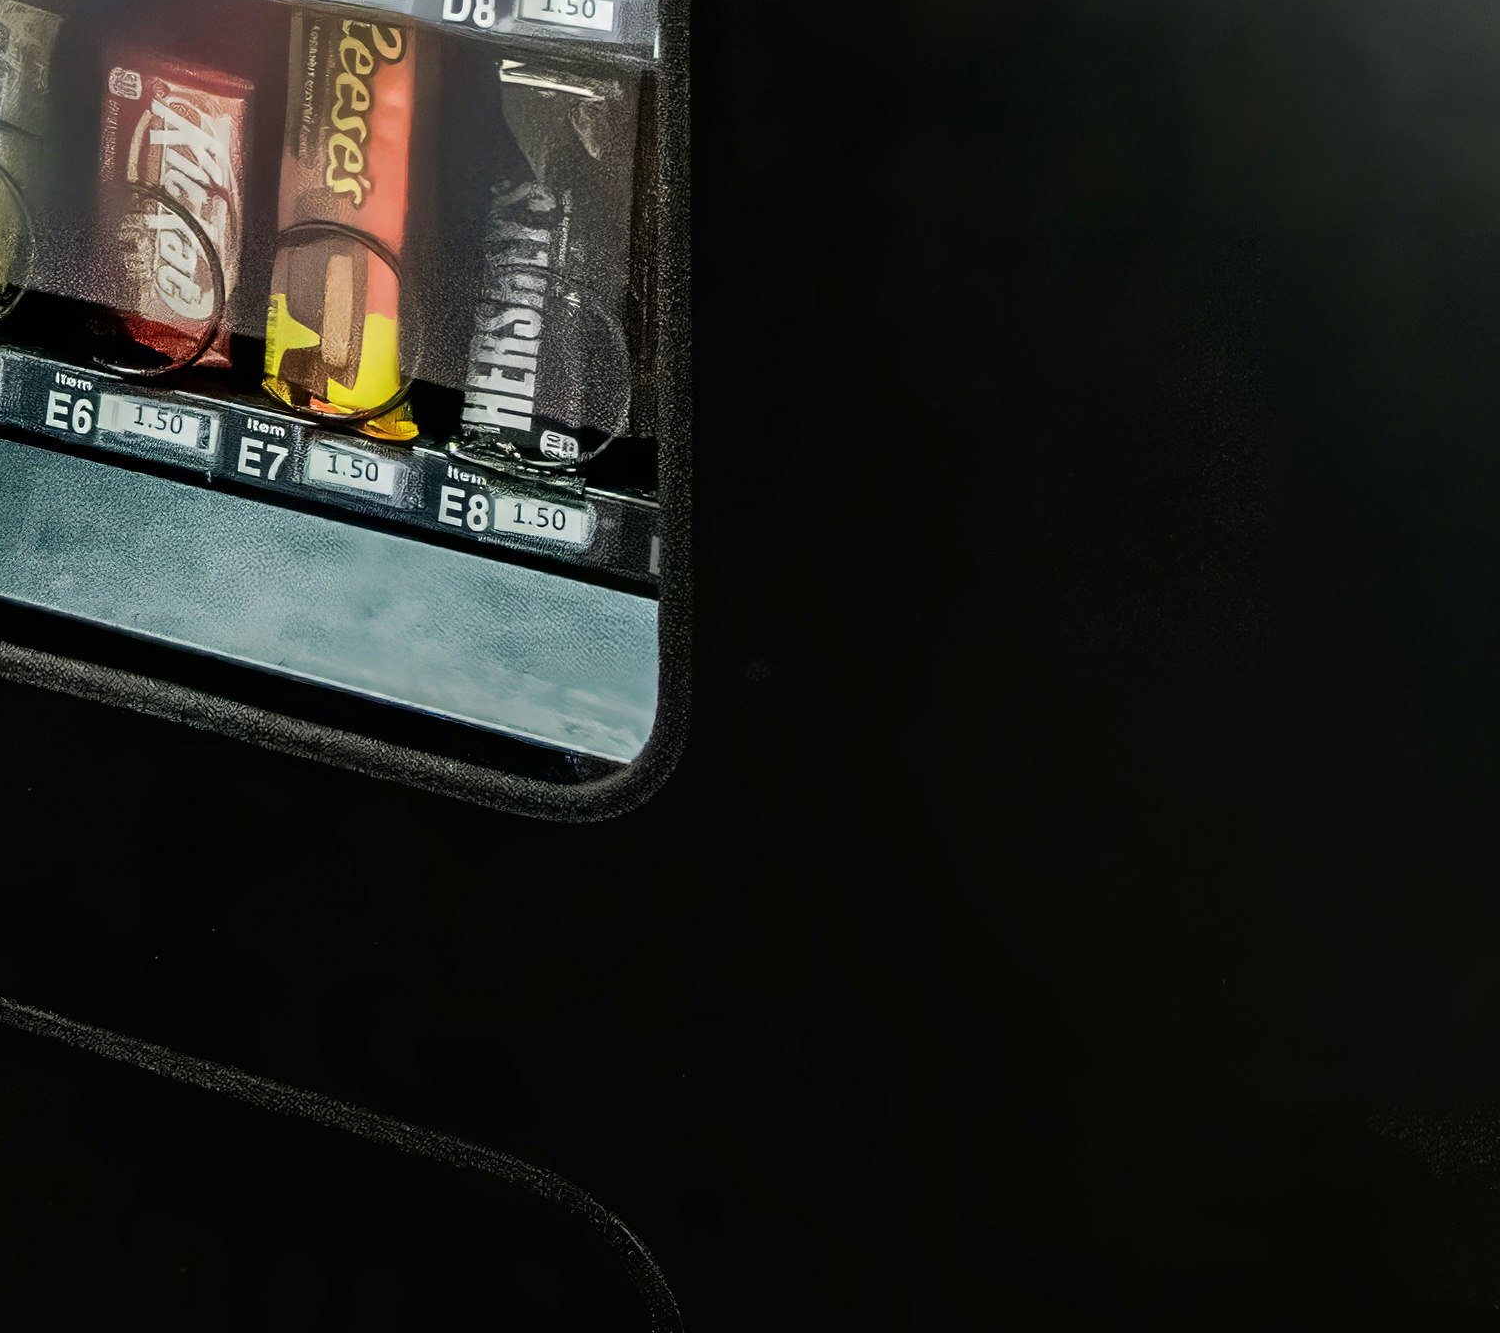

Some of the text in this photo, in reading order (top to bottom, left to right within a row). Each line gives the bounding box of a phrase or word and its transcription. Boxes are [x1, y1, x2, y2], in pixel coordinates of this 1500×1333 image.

[326, 19, 404, 210] Reese's
[45, 391, 184, 434] E6 1.50
[237, 438, 380, 484] E7 1.50
[438, 484, 567, 532] E8 1.50
